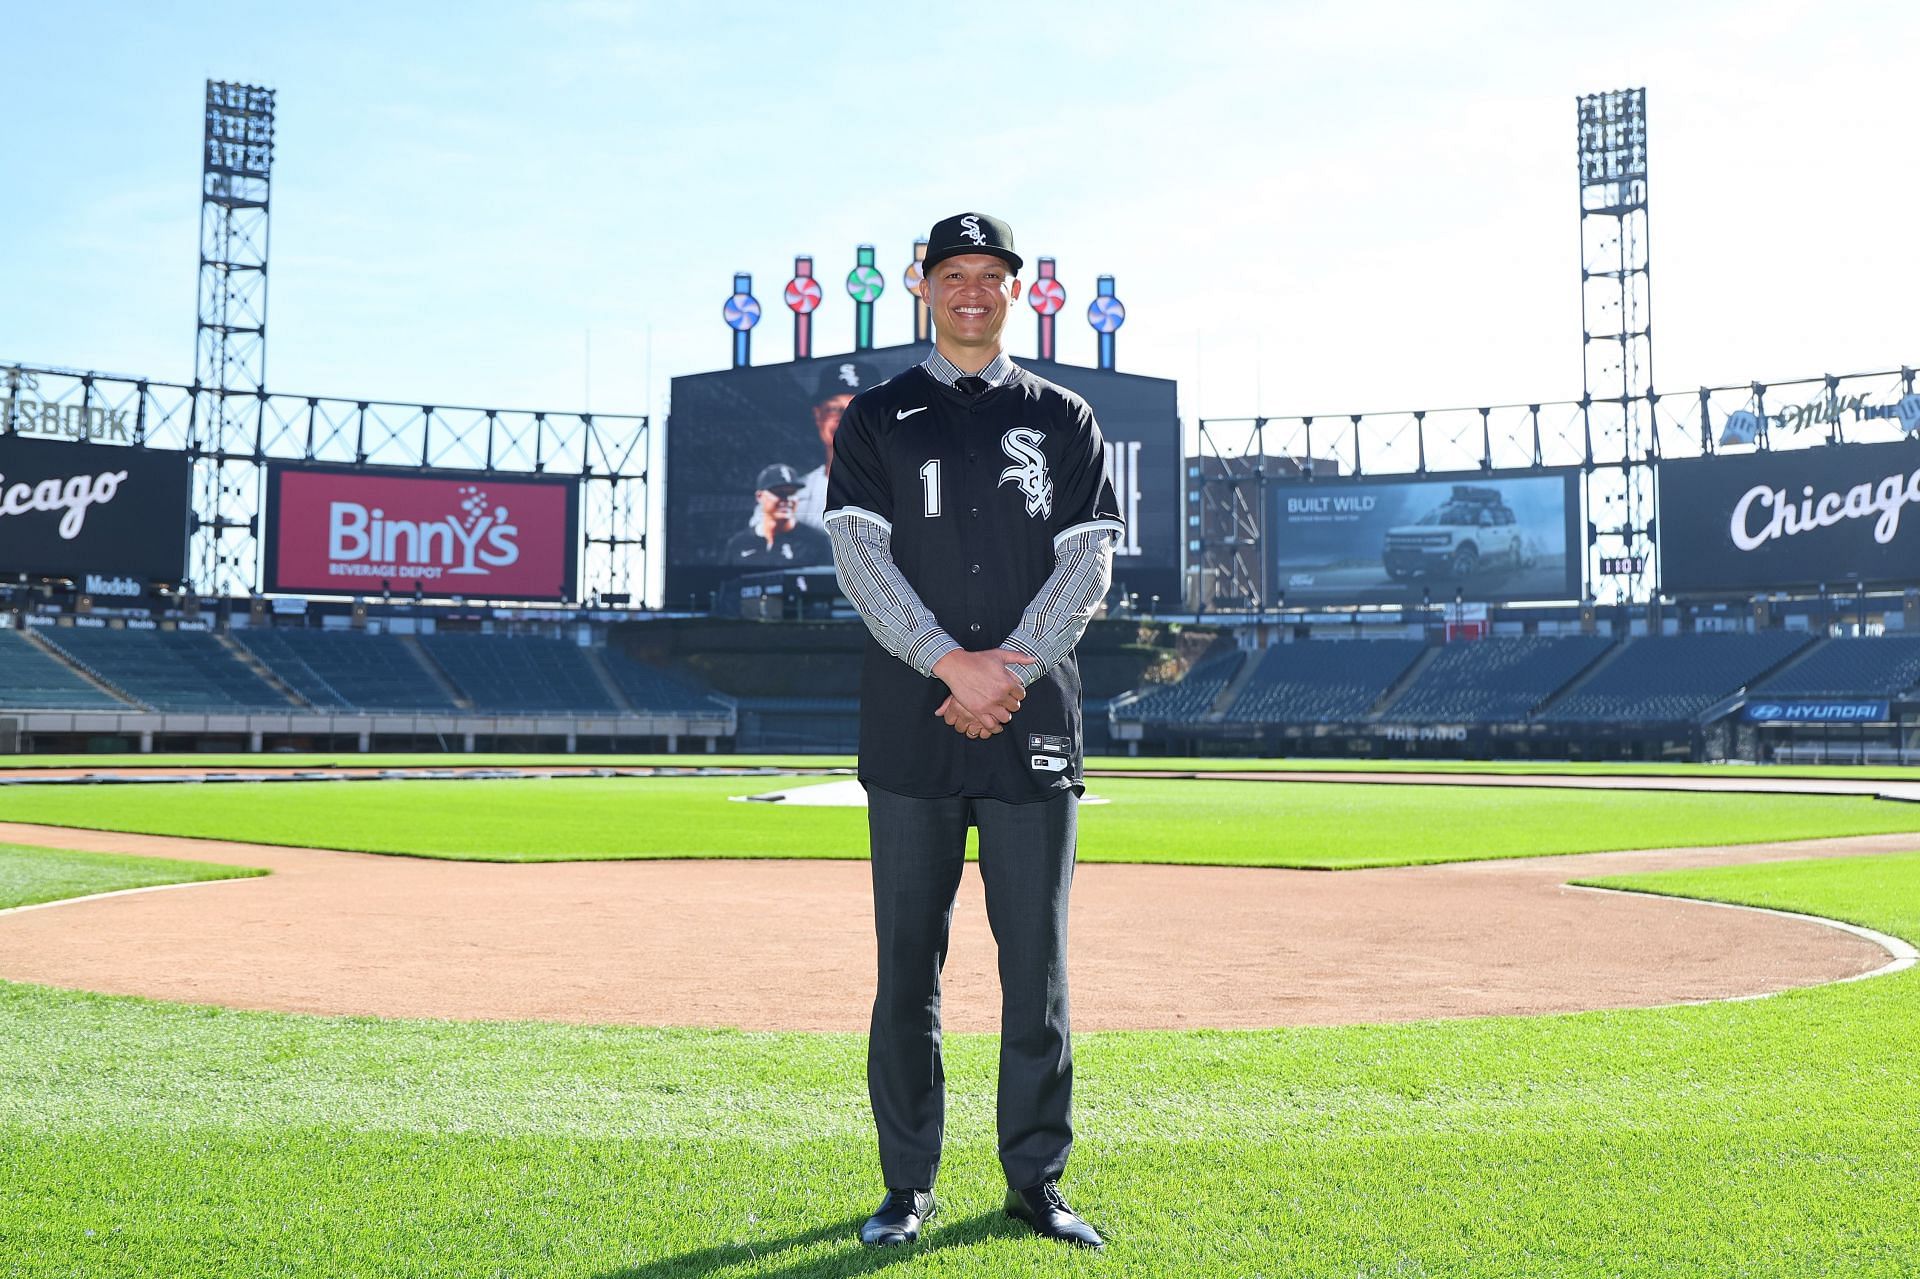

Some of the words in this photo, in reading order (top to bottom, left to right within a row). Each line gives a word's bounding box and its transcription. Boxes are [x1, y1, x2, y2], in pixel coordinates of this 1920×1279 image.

[960, 215, 986, 246] Sox
[997, 427, 1054, 521] Sox
[919, 459, 941, 517] 1
[1288, 497, 1330, 512] BUILT
[1333, 496, 1376, 511] WILD
[329, 563, 397, 577] BEVERAGE
[398, 565, 443, 579] DEPOT
[86, 574, 141, 597] Modelo
[1785, 704, 1878, 719] HYUNDAI
